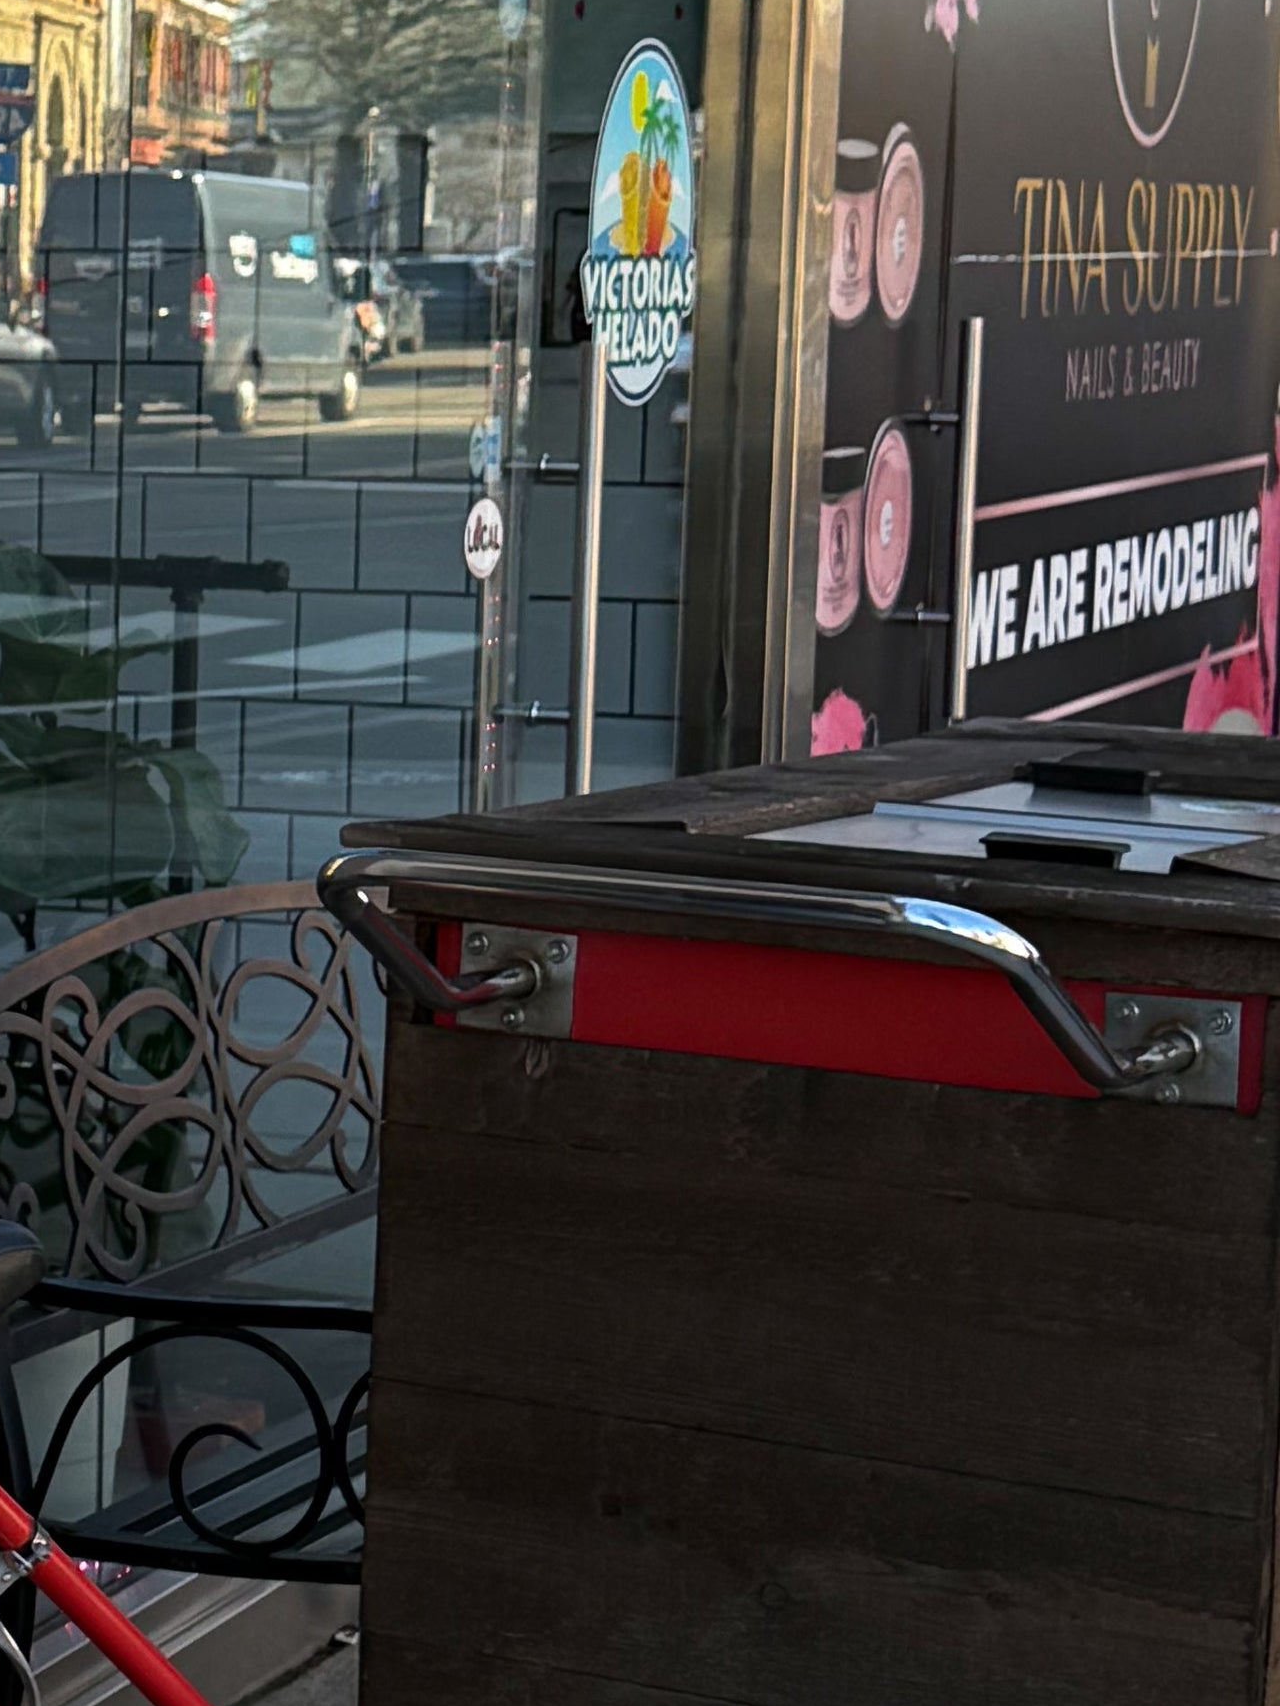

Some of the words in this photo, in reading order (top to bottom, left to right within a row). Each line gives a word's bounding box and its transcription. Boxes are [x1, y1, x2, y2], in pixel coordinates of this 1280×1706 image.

[1014, 177, 1110, 319] TINA
[1122, 178, 1255, 317] SUPPLY
[583, 257, 696, 314] VICTORIAS
[596, 309, 680, 362] HELADO
[1065, 344, 1117, 403] NAILS
[1123, 345, 1135, 397] &
[1141, 338, 1201, 394] BEAUTY
[966, 563, 1020, 670] WE
[1022, 547, 1089, 654] ARE
[1092, 506, 1259, 634] REMODELING
